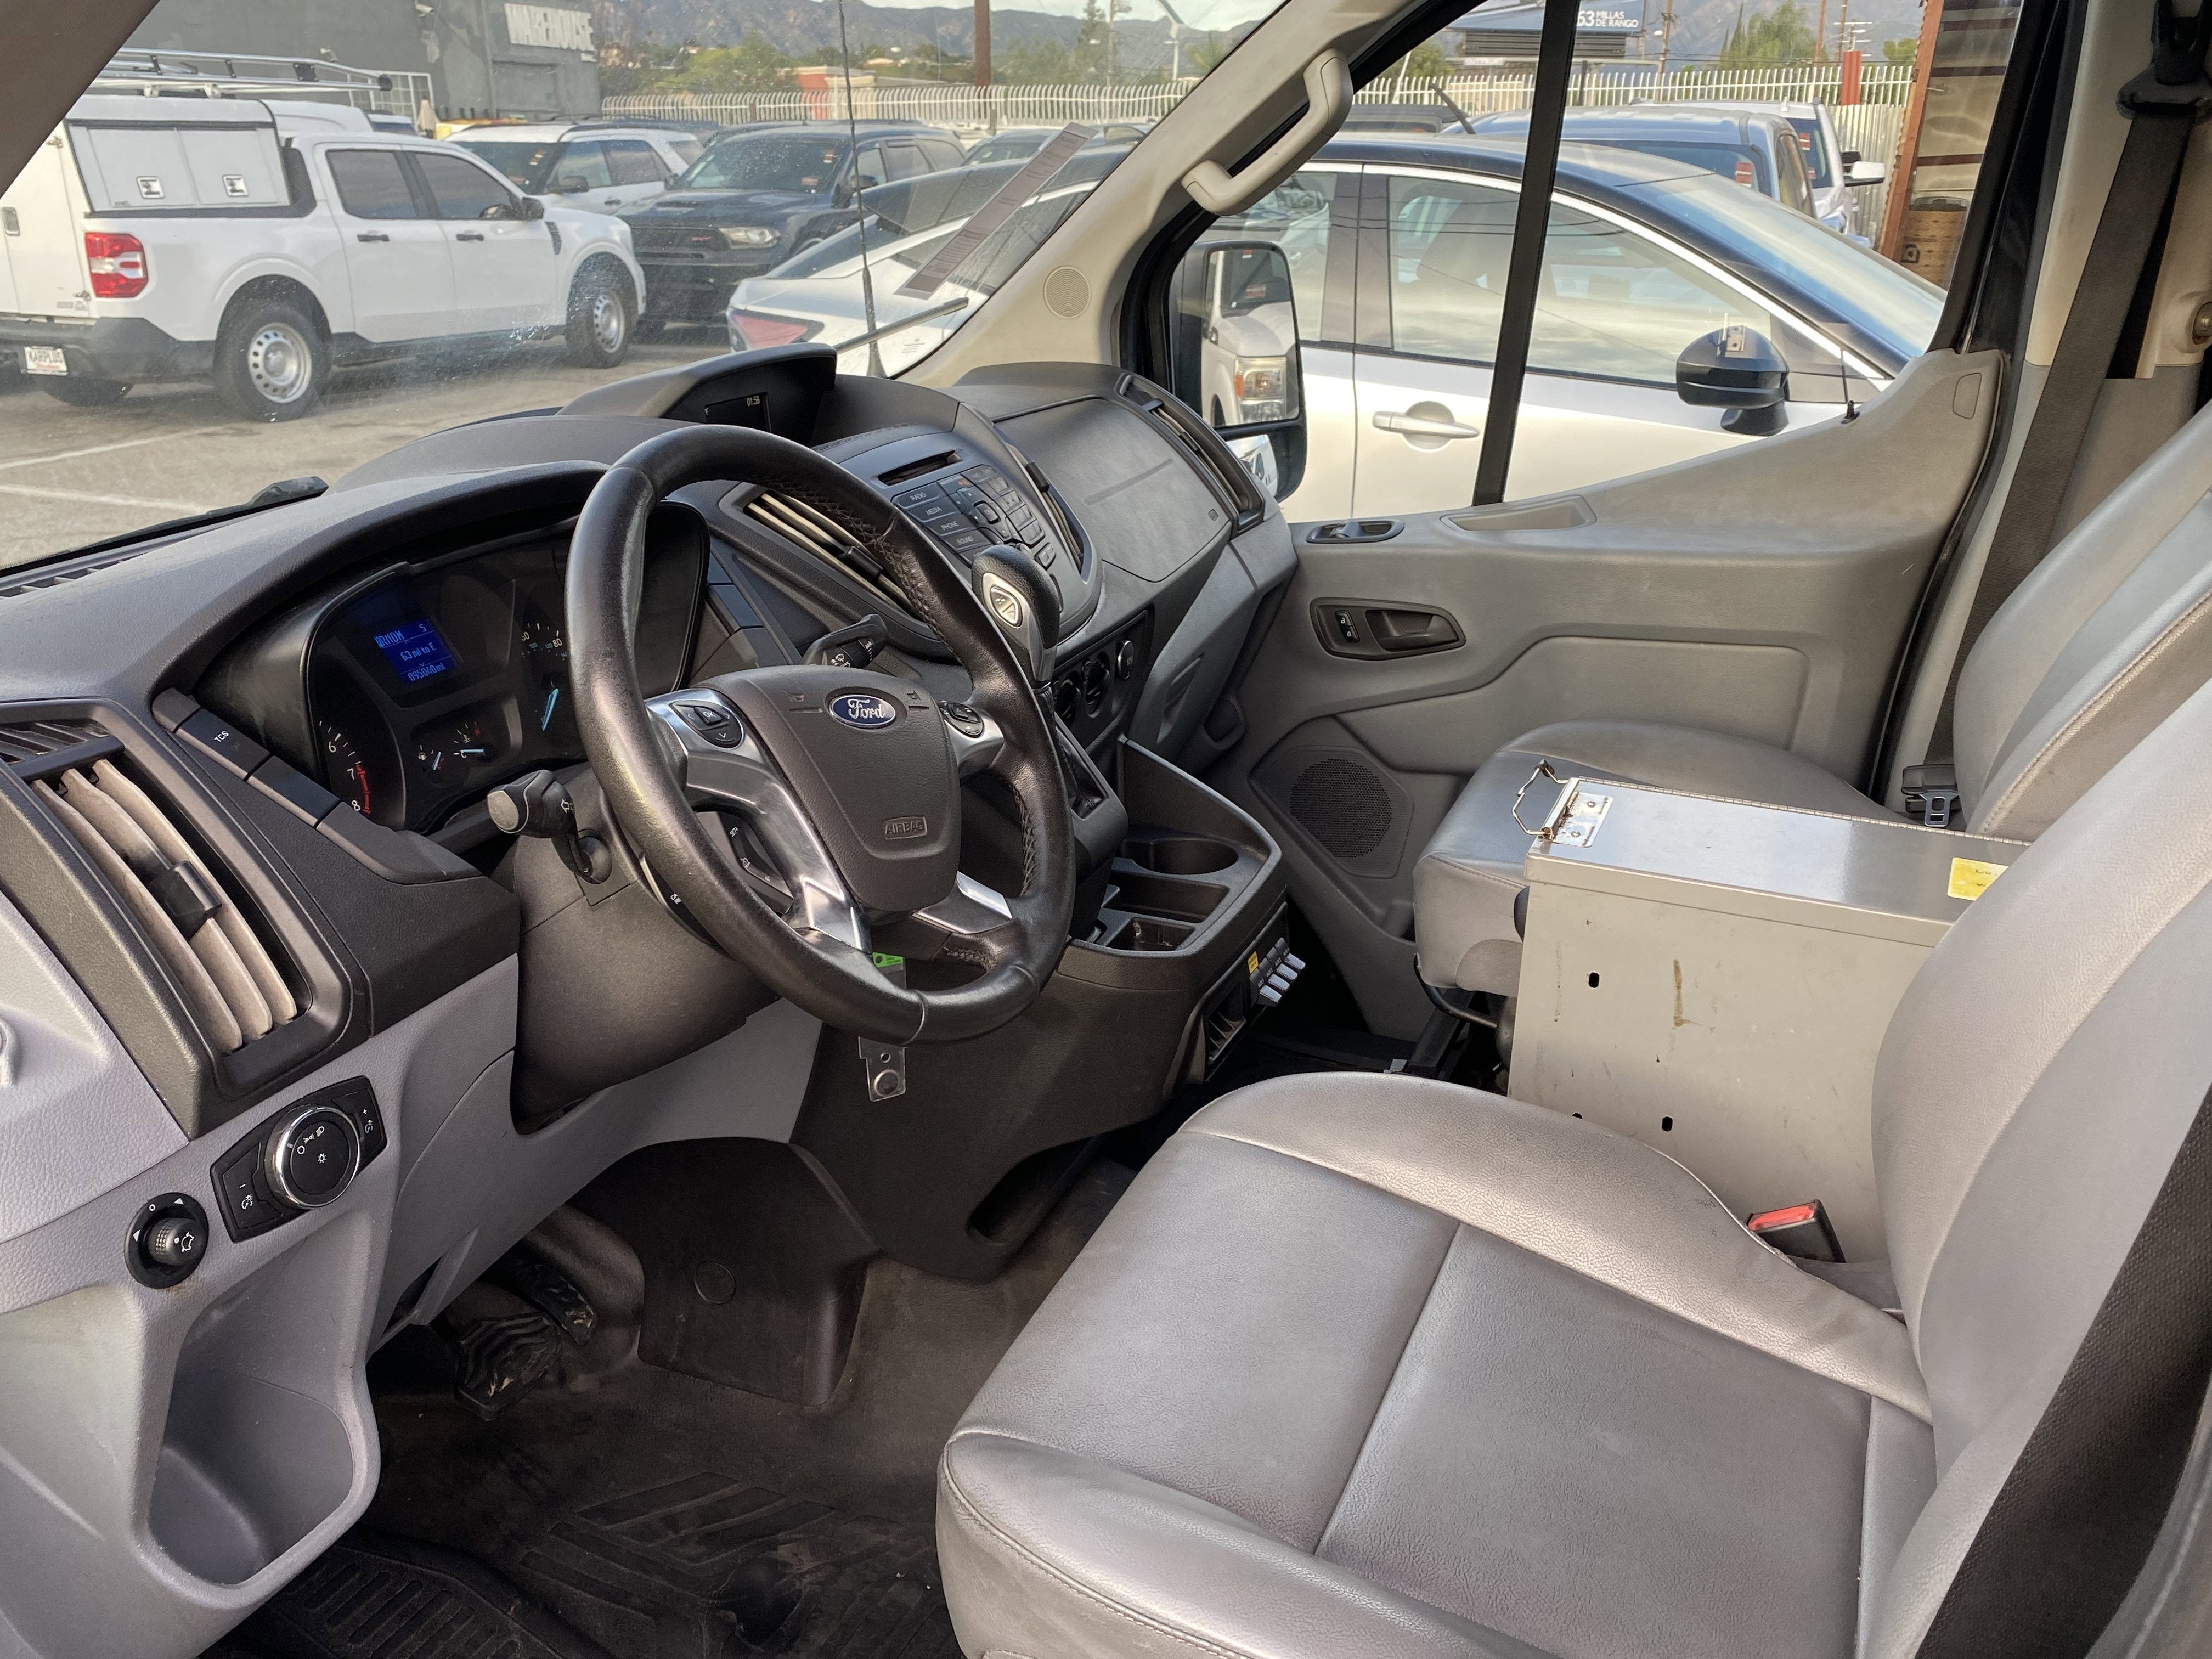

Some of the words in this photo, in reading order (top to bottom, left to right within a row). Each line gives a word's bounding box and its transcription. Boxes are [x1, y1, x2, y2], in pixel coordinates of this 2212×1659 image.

[910, 492, 927, 501] RADIO
[925, 506, 943, 516] MEDIA
[941, 521, 960, 531] PHONE
[956, 536, 974, 545] SOUND
[552, 637, 562, 647] 80
[400, 650, 412, 661] 63
[412, 647, 422, 657] mi
[421, 646, 431, 654] to
[428, 642, 437, 651] E
[847, 698, 885, 719] Ford
[214, 731, 229, 742] TCS
[329, 742, 337, 753] 6
[347, 768, 355, 780] 7
[351, 800, 361, 811] 8
[885, 821, 923, 834] AIRBAG
